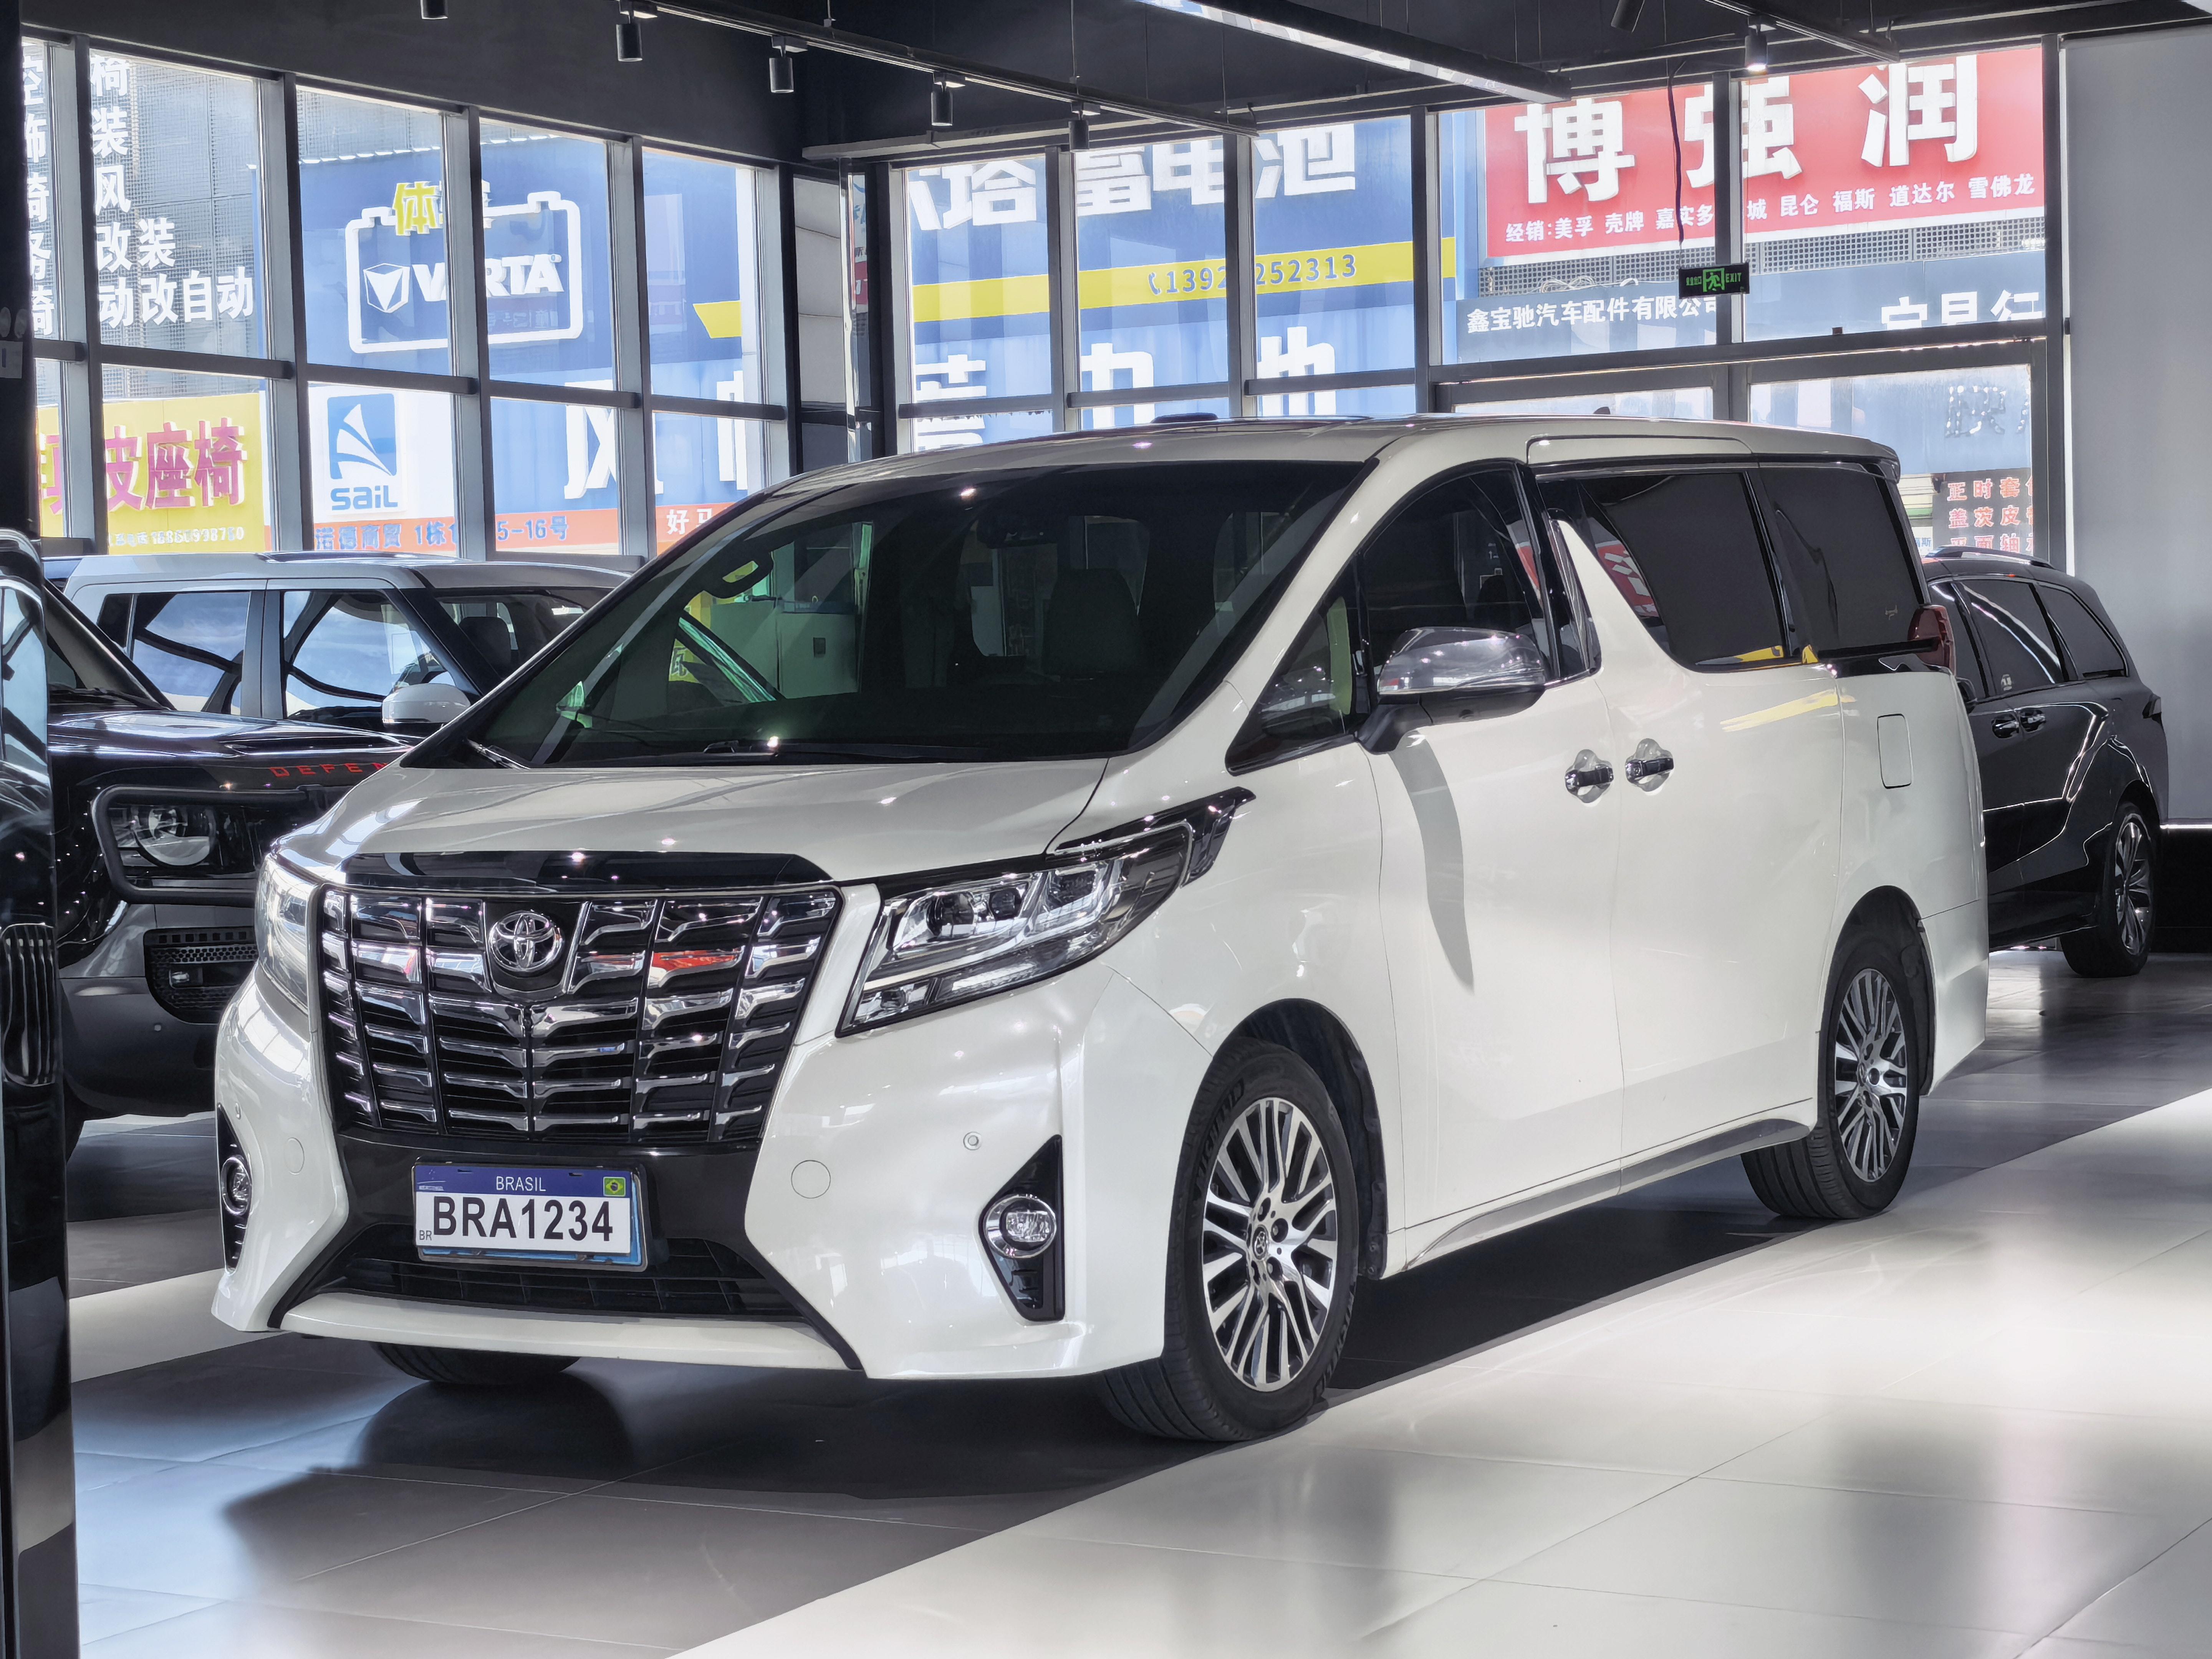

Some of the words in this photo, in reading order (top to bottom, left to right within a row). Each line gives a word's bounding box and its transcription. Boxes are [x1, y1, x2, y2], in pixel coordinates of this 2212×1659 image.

[1605, 211, 1644, 235] 壳牌
[1655, 204, 1714, 230] 嘉实多
[1747, 199, 1767, 220] 城
[1780, 194, 1819, 217] 昆仑
[1832, 187, 1875, 212] 福斯
[1889, 181, 1955, 207] 道达尔
[1968, 173, 2035, 199] 雪佛龙
[412, 255, 563, 301] VRTA
[1166, 255, 1356, 294] 1392252313
[1725, 273, 1742, 283] EXIT
[496, 1176, 546, 1192] BRASIL
[419, 1230, 432, 1241] BR
[433, 1196, 613, 1242] BRA1234
